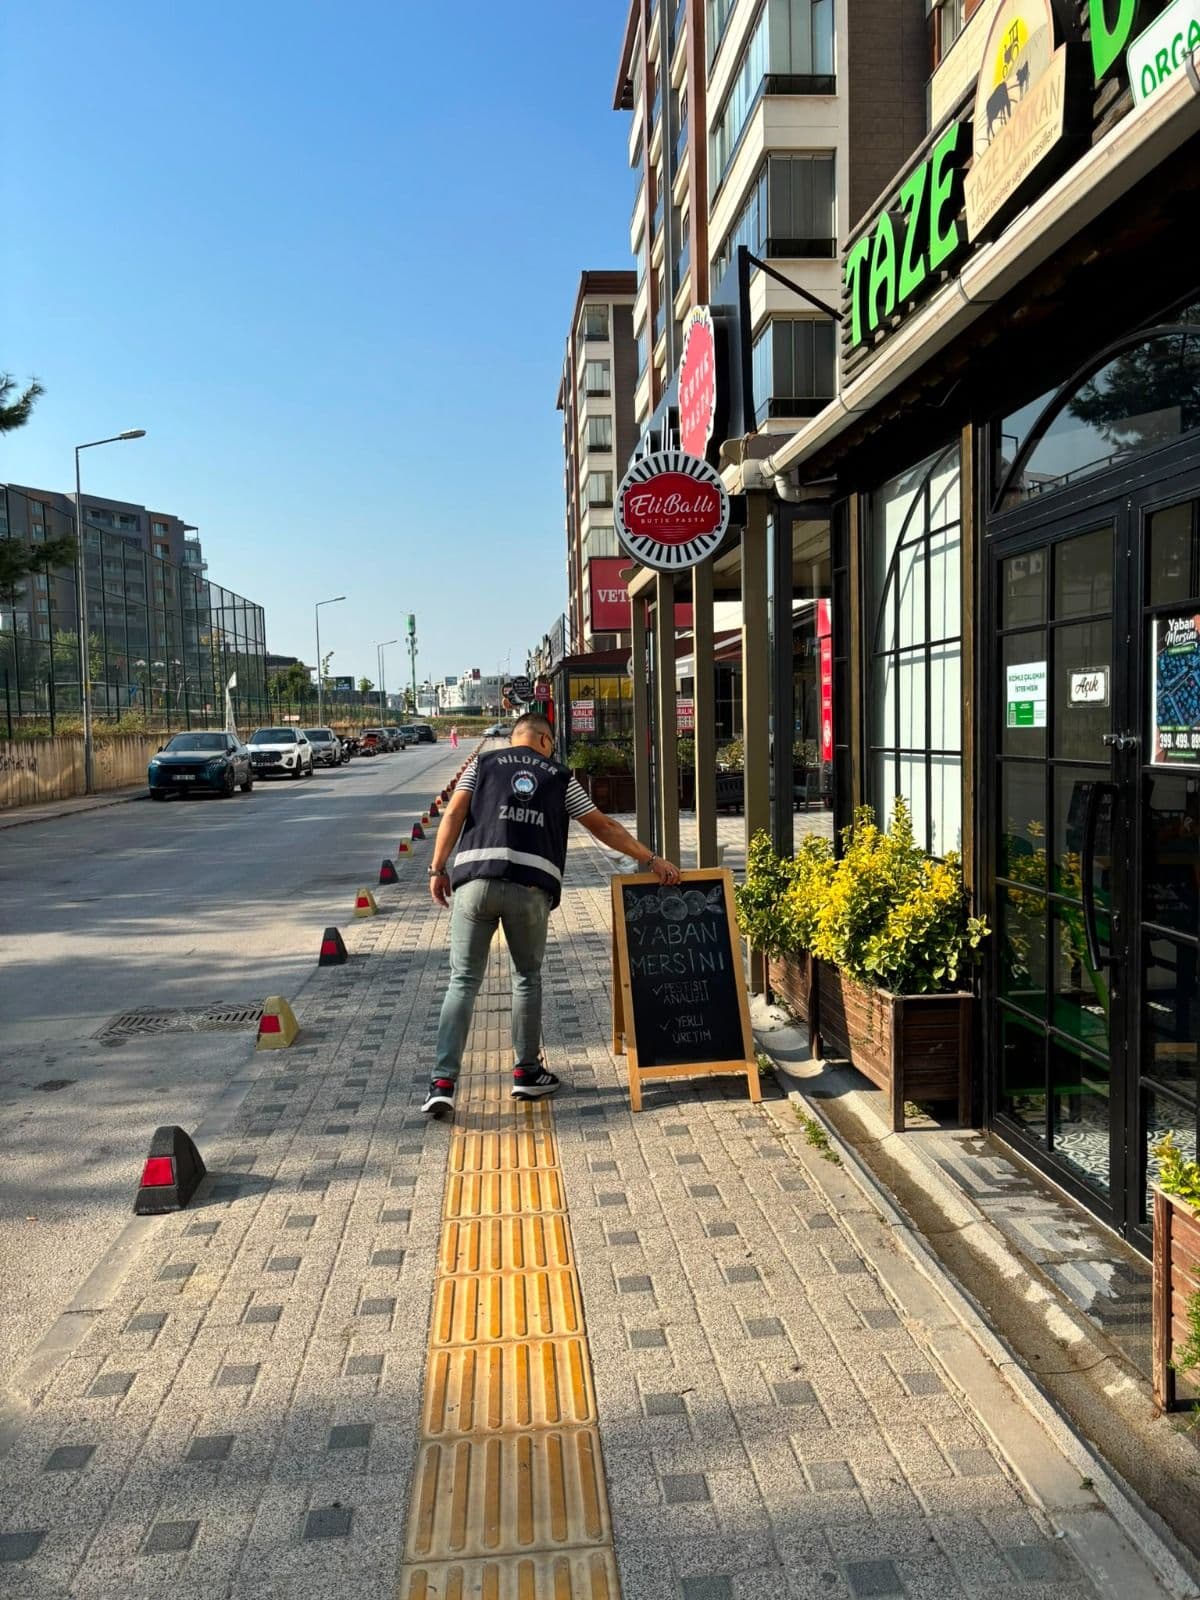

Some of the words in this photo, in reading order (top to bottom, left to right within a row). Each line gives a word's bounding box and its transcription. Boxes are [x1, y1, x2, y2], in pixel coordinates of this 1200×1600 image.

[846, 121, 959, 347] TAZE
[1168, 617, 1195, 631] Yaban
[1075, 675, 1098, 698] Açık
[499, 805, 544, 828] ZABITA
[633, 921, 717, 945] YABAN
